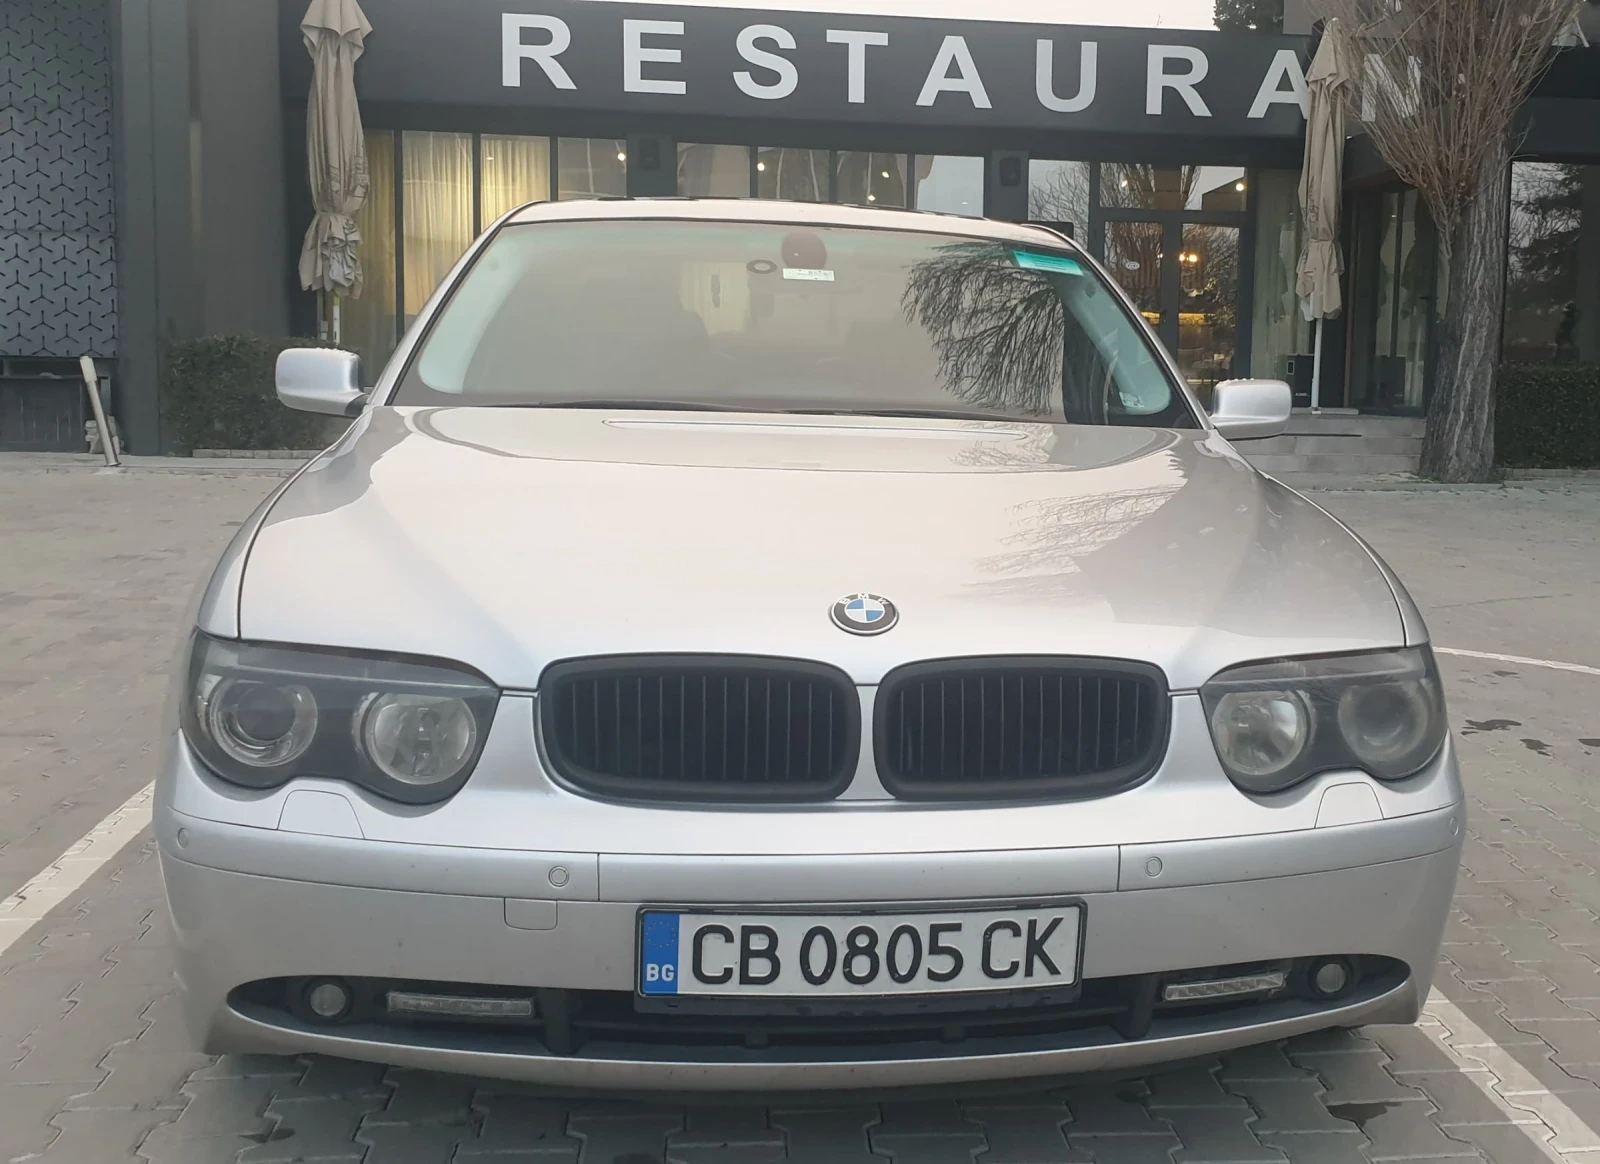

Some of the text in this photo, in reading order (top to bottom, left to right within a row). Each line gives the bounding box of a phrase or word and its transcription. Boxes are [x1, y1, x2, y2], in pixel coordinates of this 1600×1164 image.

[502, 12, 1467, 122] RESTAURAN
[838, 592, 891, 605] BMW
[646, 963, 675, 982] BG
[691, 916, 1065, 986] CB 0805 CK
